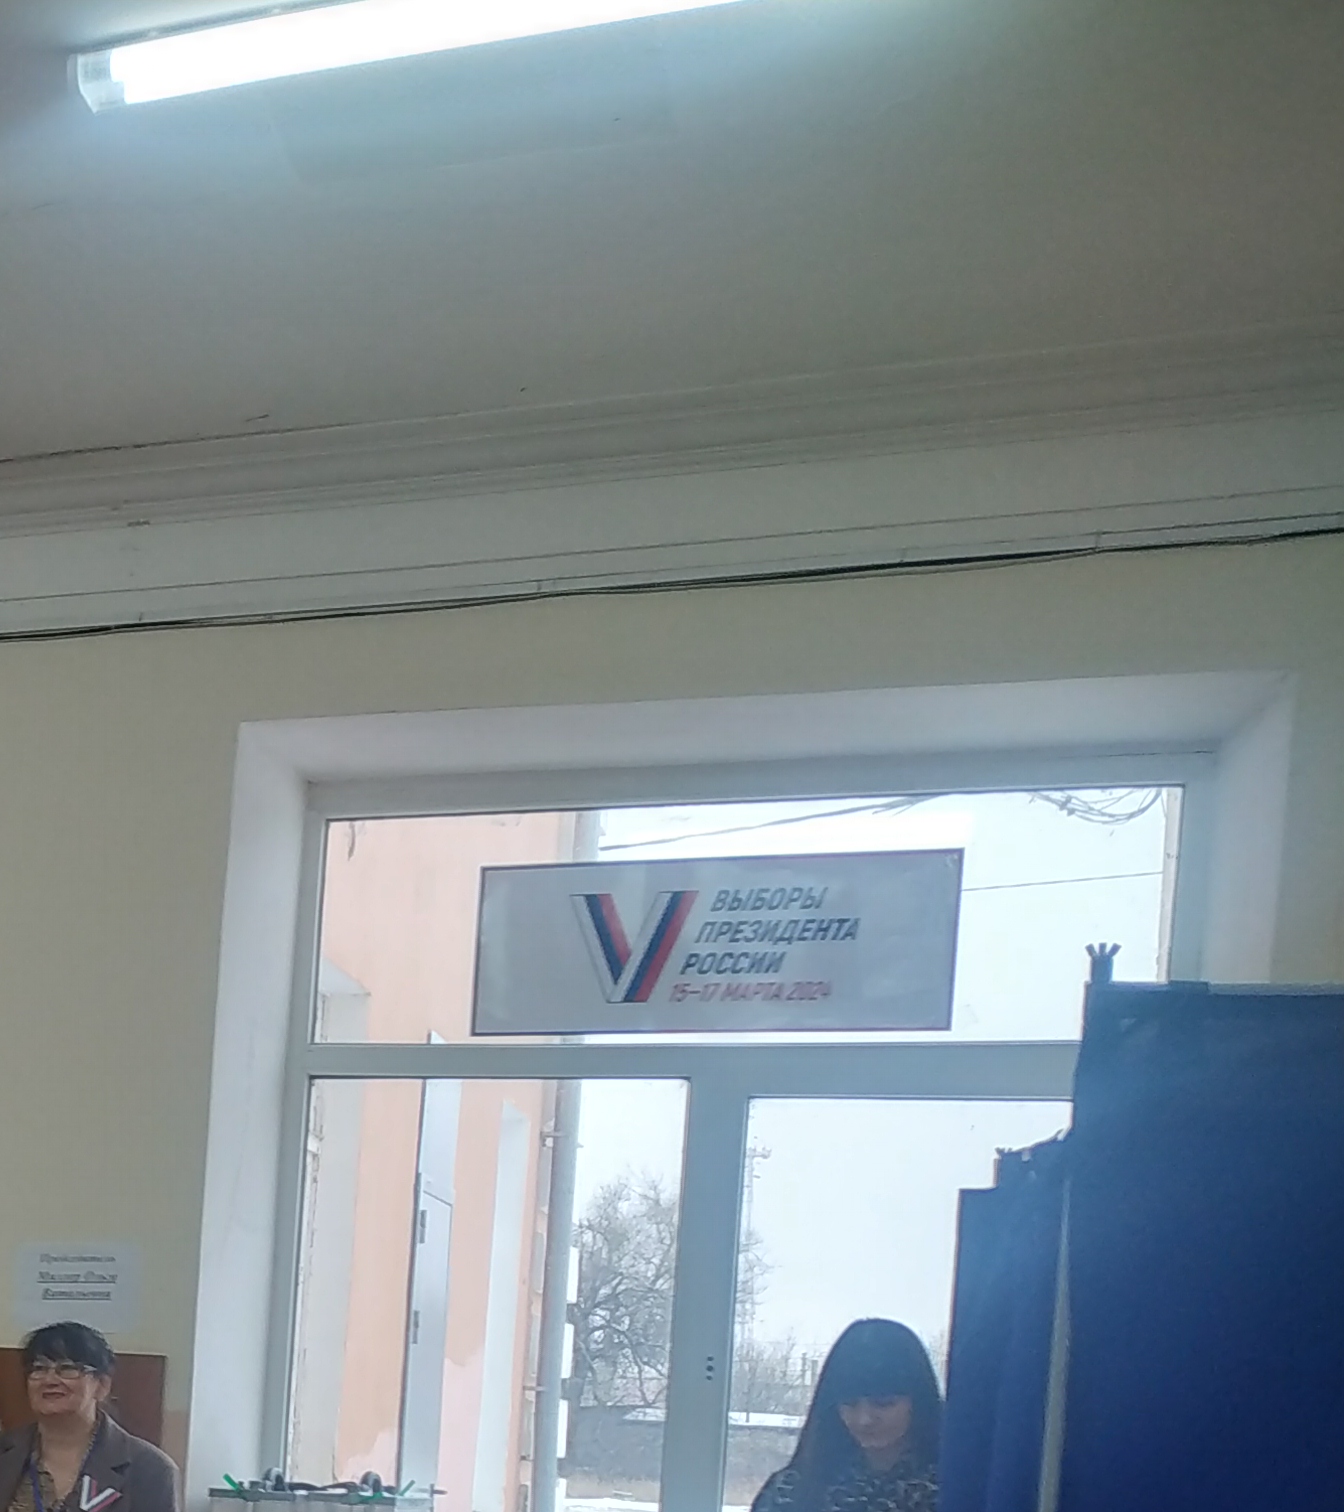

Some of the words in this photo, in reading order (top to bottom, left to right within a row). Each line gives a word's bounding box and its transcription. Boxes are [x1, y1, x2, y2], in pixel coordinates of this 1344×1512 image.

[710, 886, 829, 913] ВЫБОРЫ
[694, 916, 861, 946] ПРЕЗИДЕНТА
[679, 950, 787, 976] РОССИИ
[720, 981, 785, 1003] МАРТА
